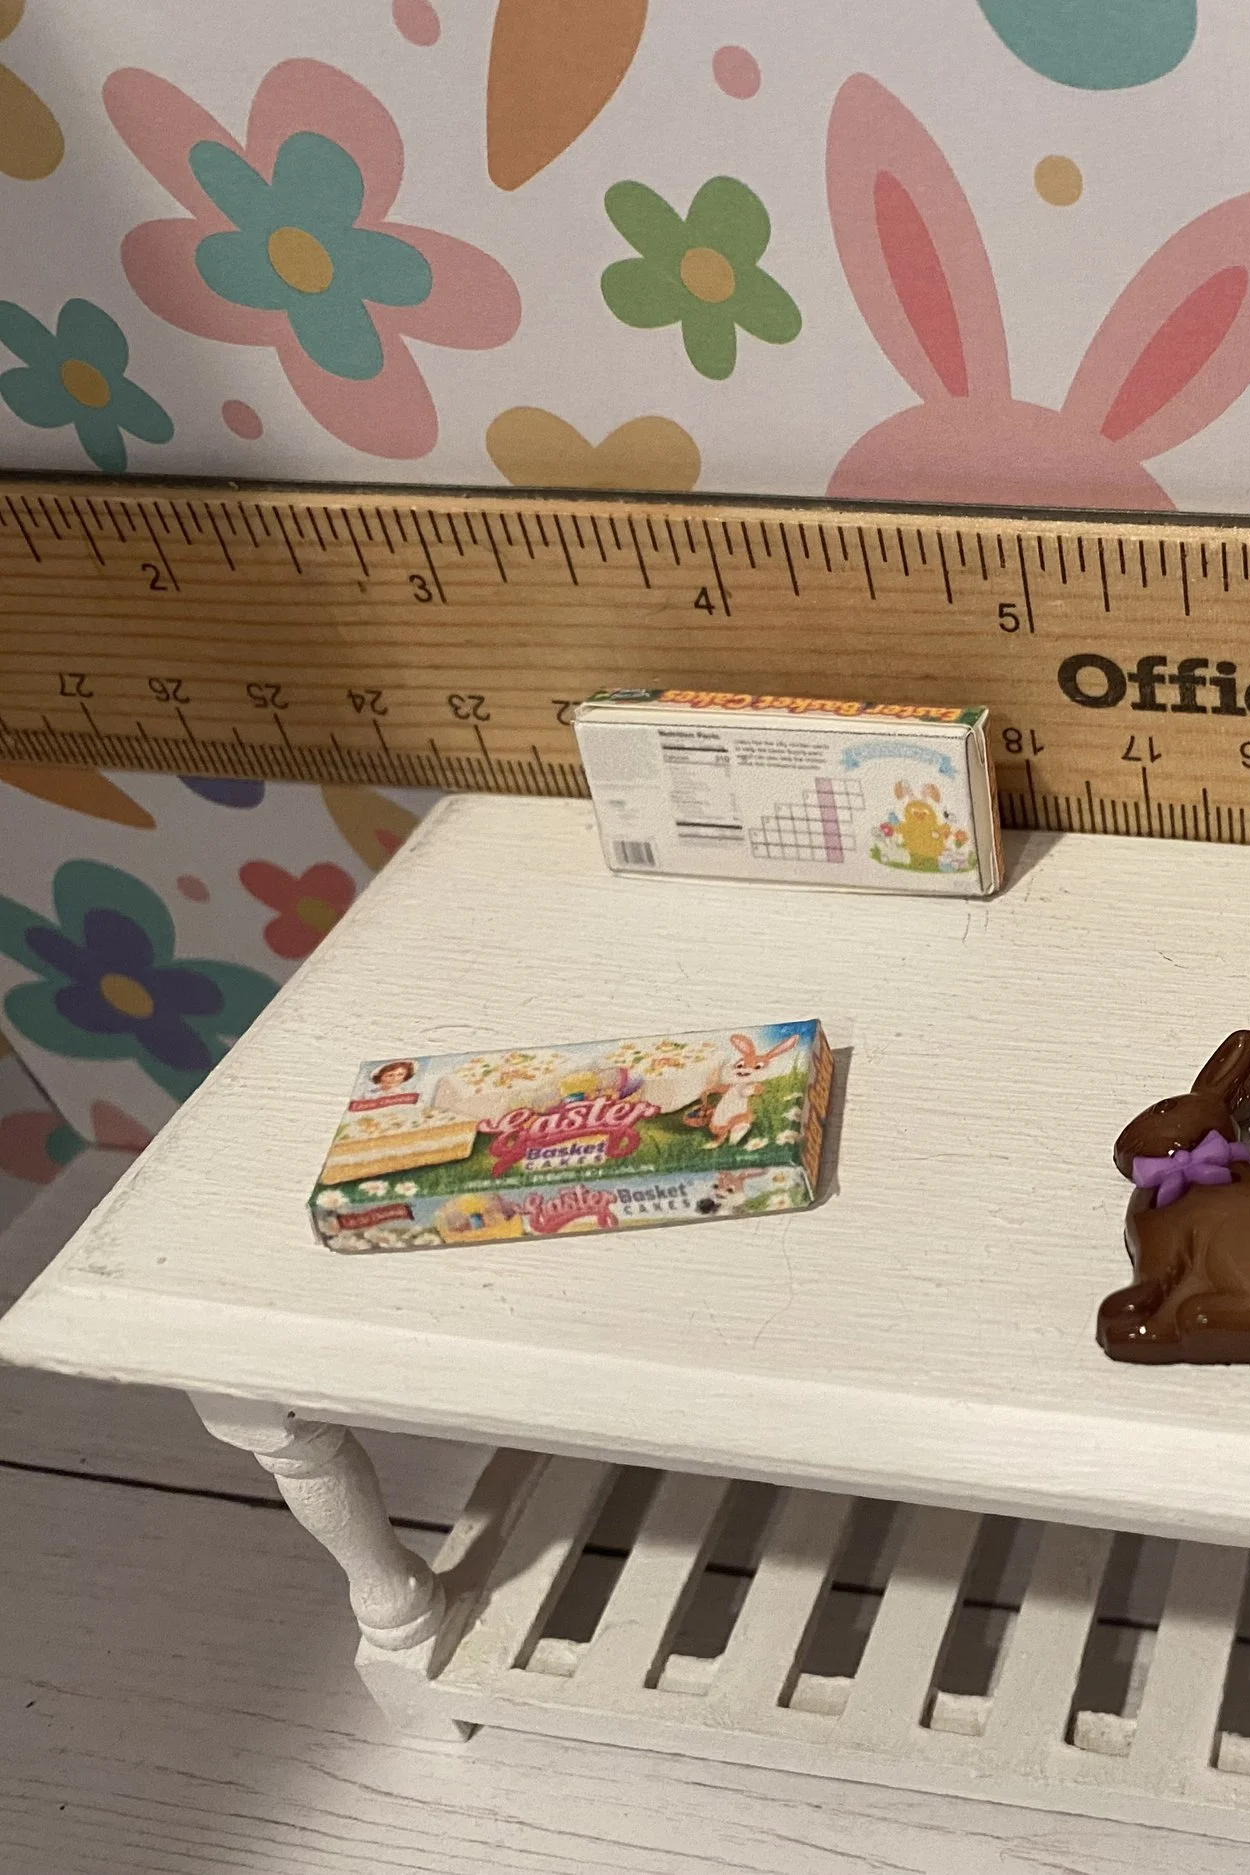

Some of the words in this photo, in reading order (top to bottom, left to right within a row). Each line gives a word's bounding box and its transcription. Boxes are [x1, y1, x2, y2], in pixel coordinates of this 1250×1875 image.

[141, 563, 167, 591] 2
[408, 574, 433, 604] 3
[693, 585, 716, 616] 4
[998, 602, 1021, 634] 5
[58, 672, 94, 699] 27
[148, 677, 191, 704] 26
[246, 682, 289, 710] 25
[660, 689, 750, 709] Cakes
[346, 689, 388, 716] 24
[447, 694, 491, 722] 23
[752, 695, 864, 717] Basket
[865, 703, 962, 721] Easter
[1000, 726, 1045, 756] 18
[1120, 735, 1163, 764] 17
[477, 1094, 662, 1162] Easter
[525, 1155, 606, 1171] CAKES
[526, 1140, 607, 1162] Basket
[521, 1183, 619, 1228] Easter
[616, 1182, 687, 1204] Basket
